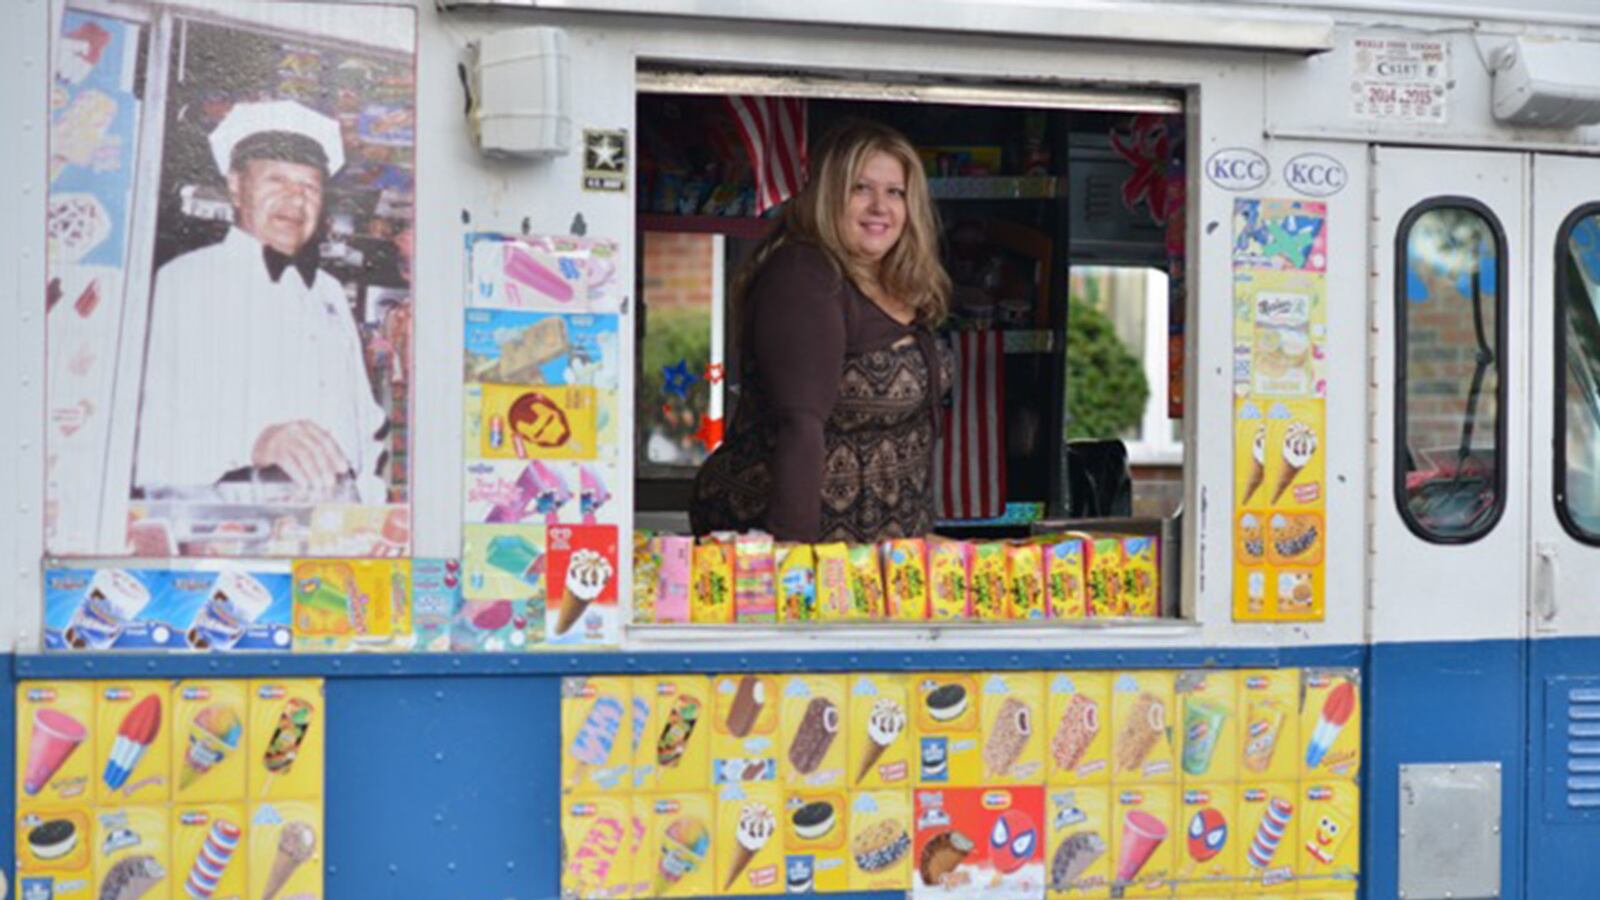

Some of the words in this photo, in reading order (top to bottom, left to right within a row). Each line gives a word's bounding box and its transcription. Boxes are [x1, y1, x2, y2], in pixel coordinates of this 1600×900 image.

[1369, 87, 1396, 104] 2014
[1404, 89, 1432, 105] 2015
[1214, 159, 1263, 180] KCC
[1292, 163, 1341, 187] KCC
